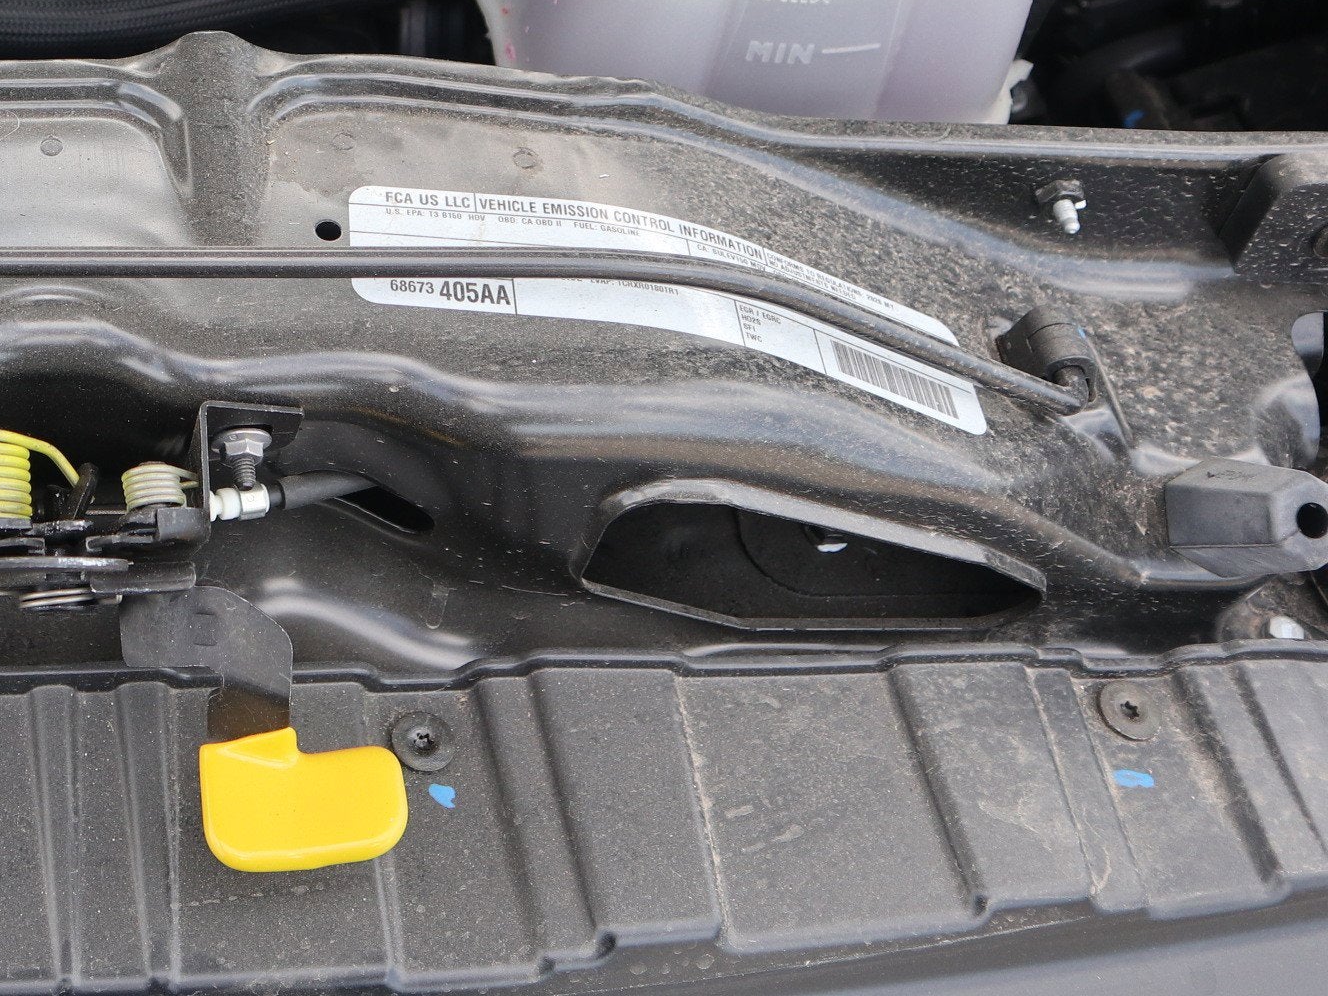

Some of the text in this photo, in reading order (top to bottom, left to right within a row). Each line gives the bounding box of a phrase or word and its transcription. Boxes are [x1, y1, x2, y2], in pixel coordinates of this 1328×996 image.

[745, 40, 816, 65] MIN
[385, 191, 763, 261] FCA US LLC VEHICLE EMISSION CONTROL INFORMATION
[536, 219, 553, 227] OBD
[574, 221, 598, 231] FUEL:
[600, 225, 641, 237] GASOLINE
[390, 278, 512, 306] 68673 405AA
